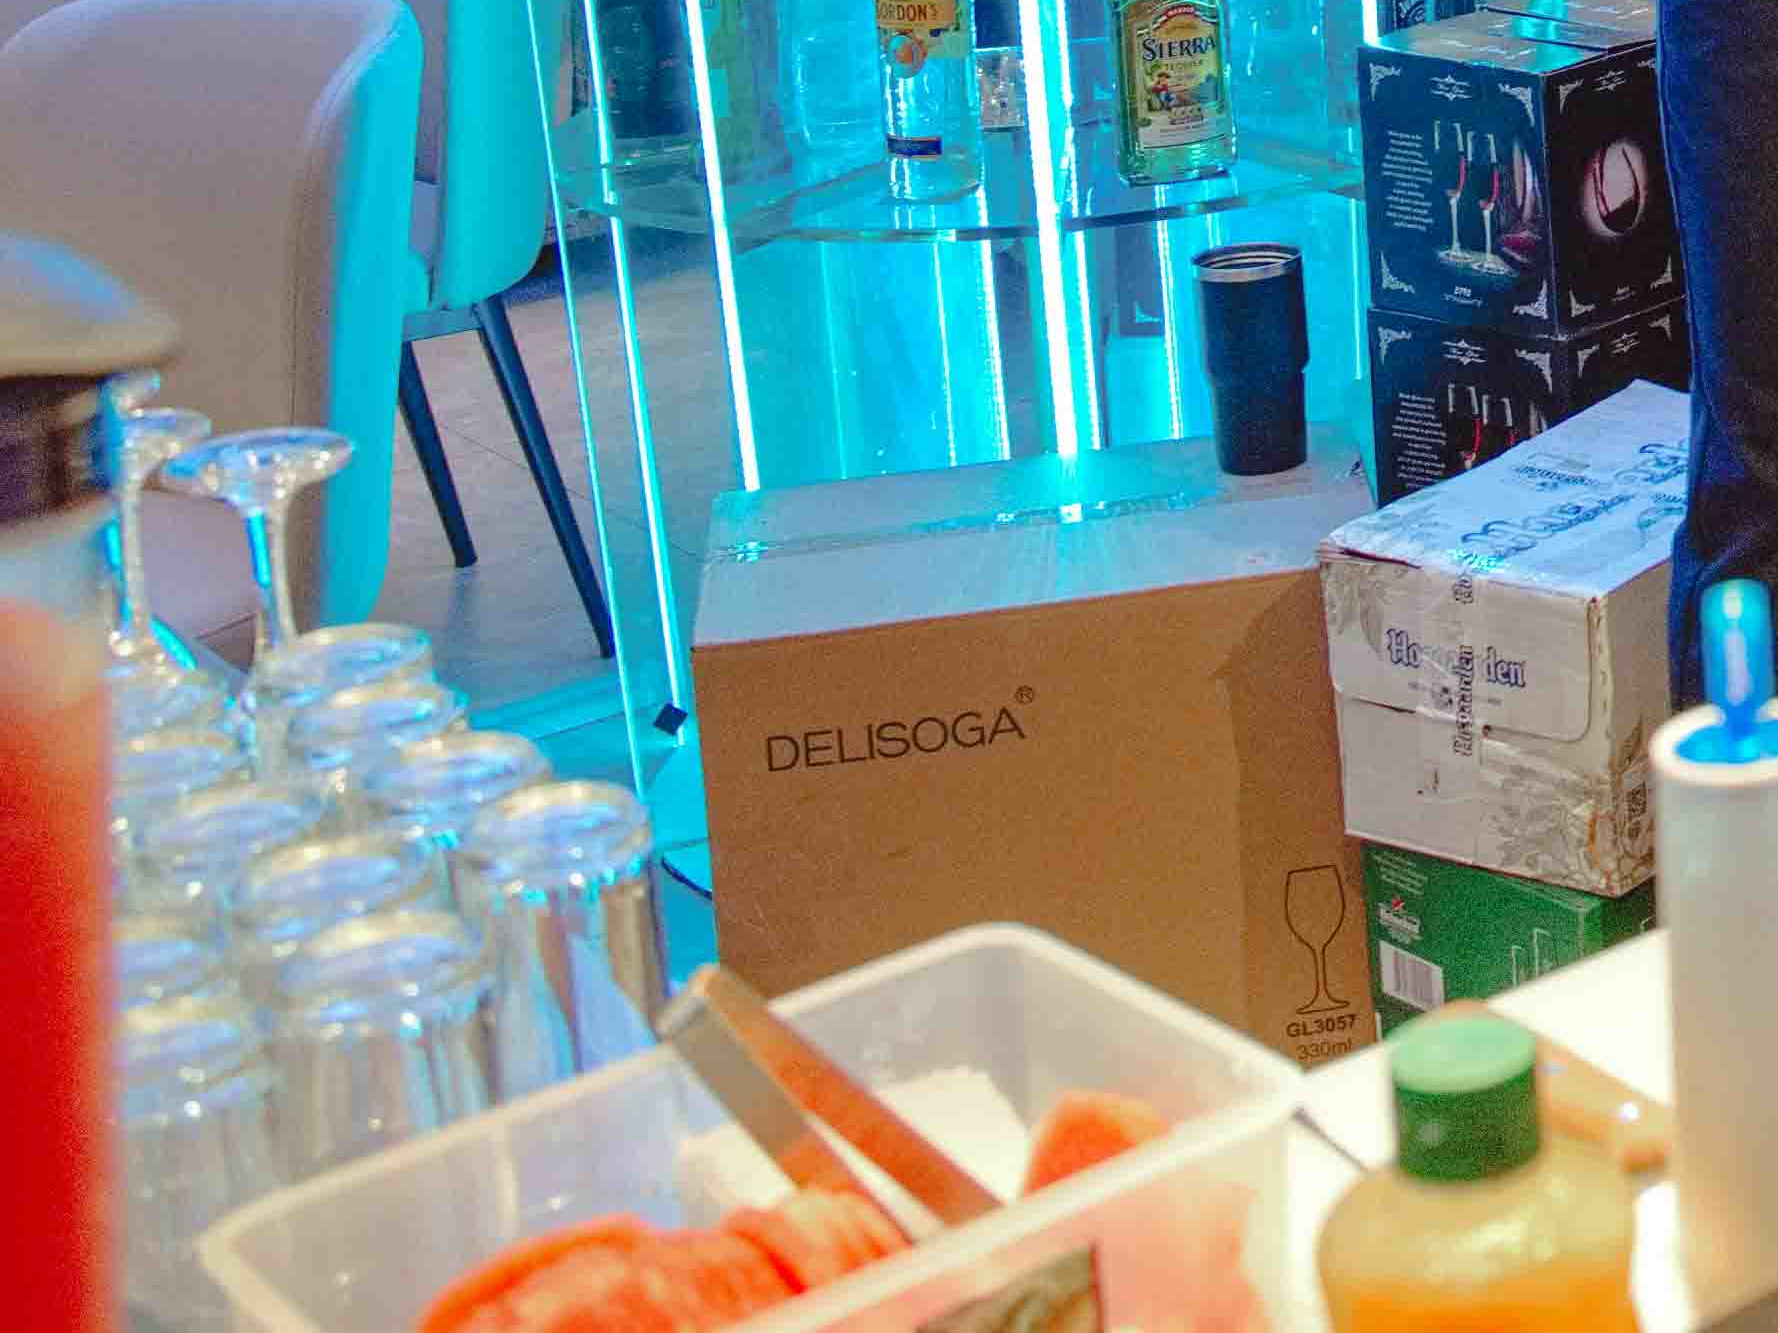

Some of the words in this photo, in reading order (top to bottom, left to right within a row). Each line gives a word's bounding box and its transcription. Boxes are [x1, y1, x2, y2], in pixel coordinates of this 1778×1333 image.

[1142, 35, 1216, 62] SIERRA
[1285, 1013, 1357, 1038] GL3057
[1297, 1038, 1353, 1061] 330ml
